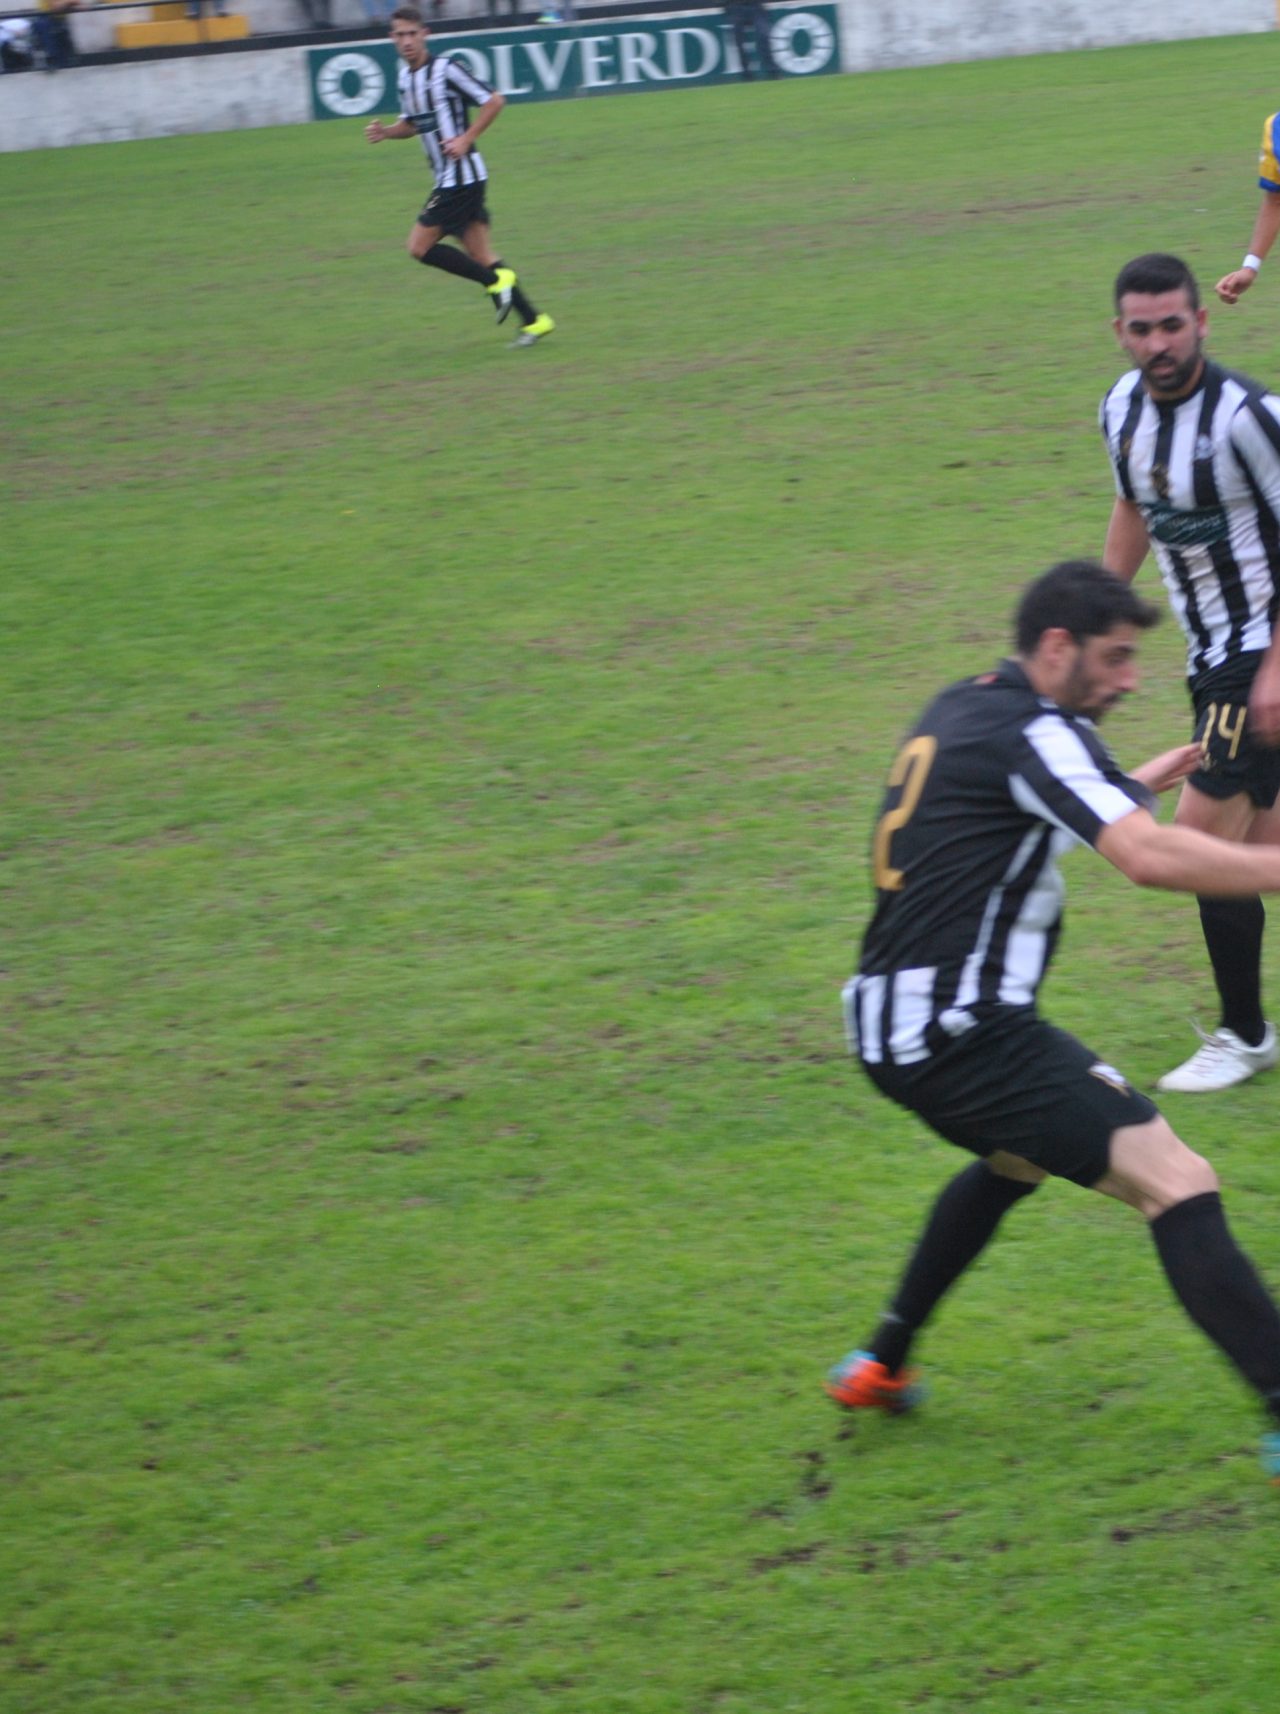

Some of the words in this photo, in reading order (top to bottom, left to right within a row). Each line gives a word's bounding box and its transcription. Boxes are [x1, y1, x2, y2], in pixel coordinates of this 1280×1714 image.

[397, 24, 761, 96] OLVERDE
[1200, 701, 1247, 759] 14
[874, 735, 938, 890] 2
